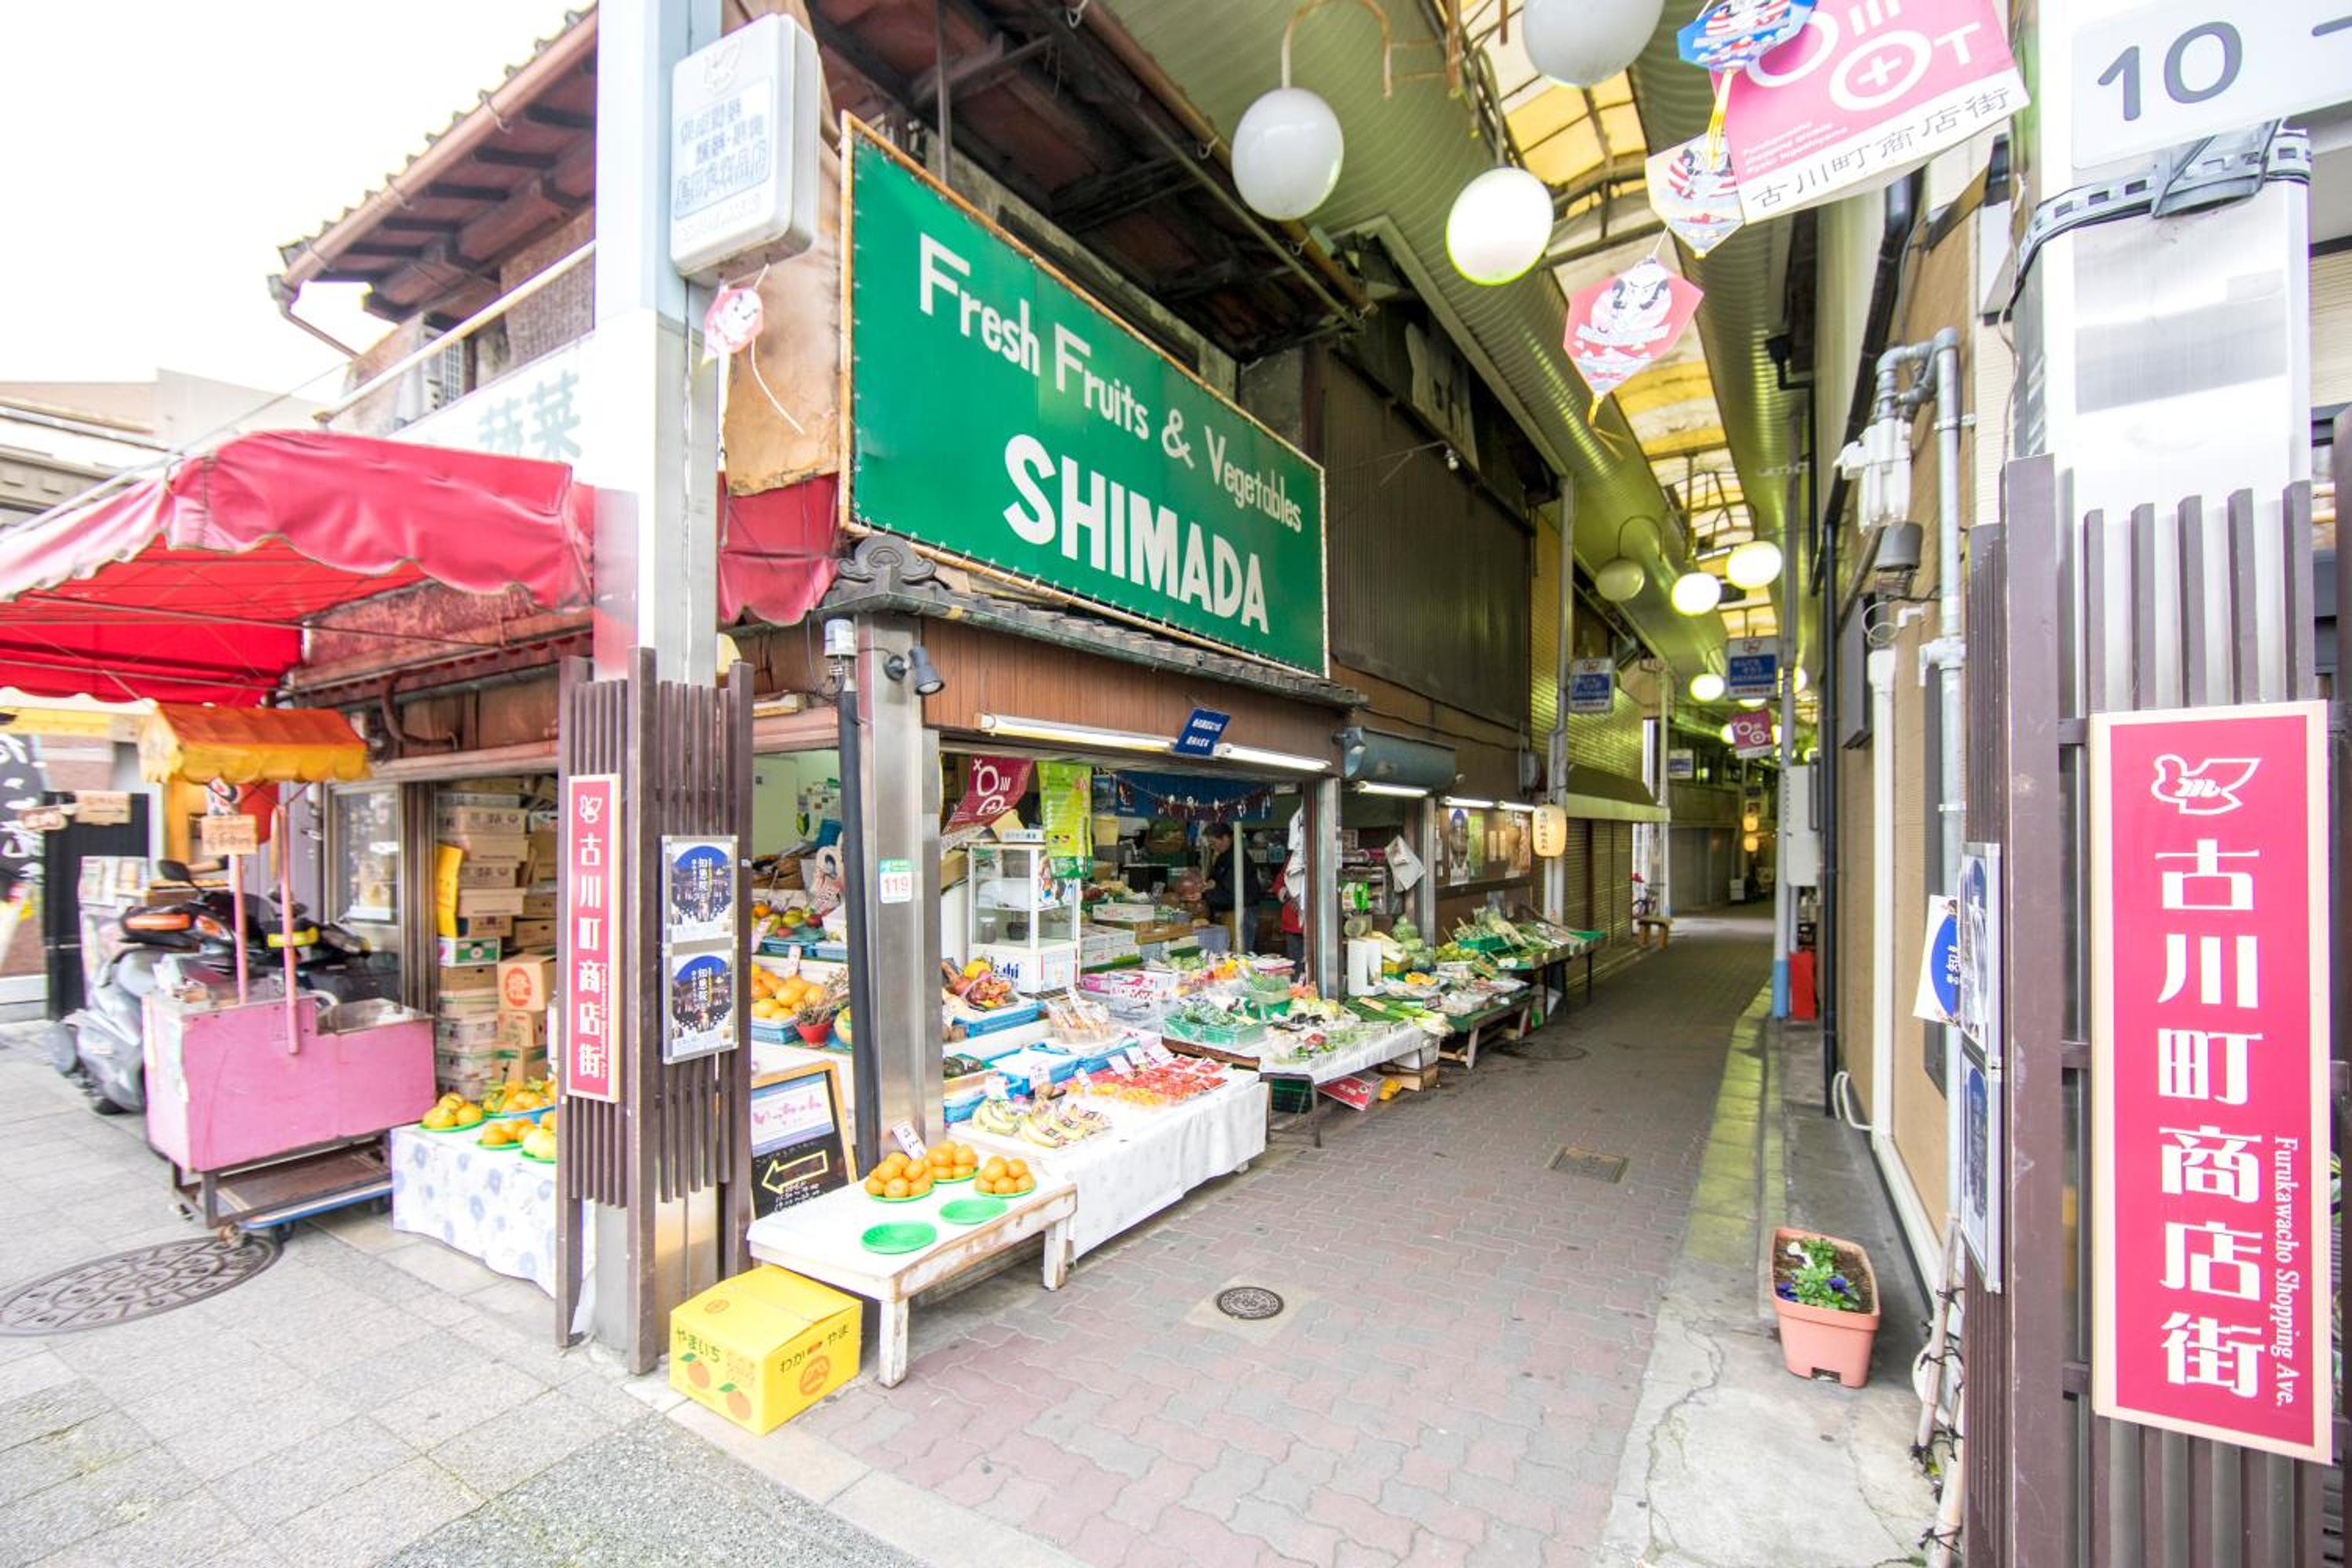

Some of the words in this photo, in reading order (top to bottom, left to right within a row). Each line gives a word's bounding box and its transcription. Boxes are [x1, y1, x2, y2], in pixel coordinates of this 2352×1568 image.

[1750, 87, 2013, 208] 古川町商店街
[920, 232, 1040, 376] Fresh
[1054, 322, 1149, 440] Fruits
[1160, 408, 1195, 469] &
[1204, 426, 1302, 533] Vegetables
[1003, 434, 1269, 634] SHIMADA
[578, 832, 602, 1079] 古川町商店街
[2154, 838, 2265, 1399] 古川町商店街
[2274, 1135, 2299, 1264] Furukawacho
[2270, 1268, 2301, 1359] Shopping
[2276, 1364, 2301, 1406] Ave.
